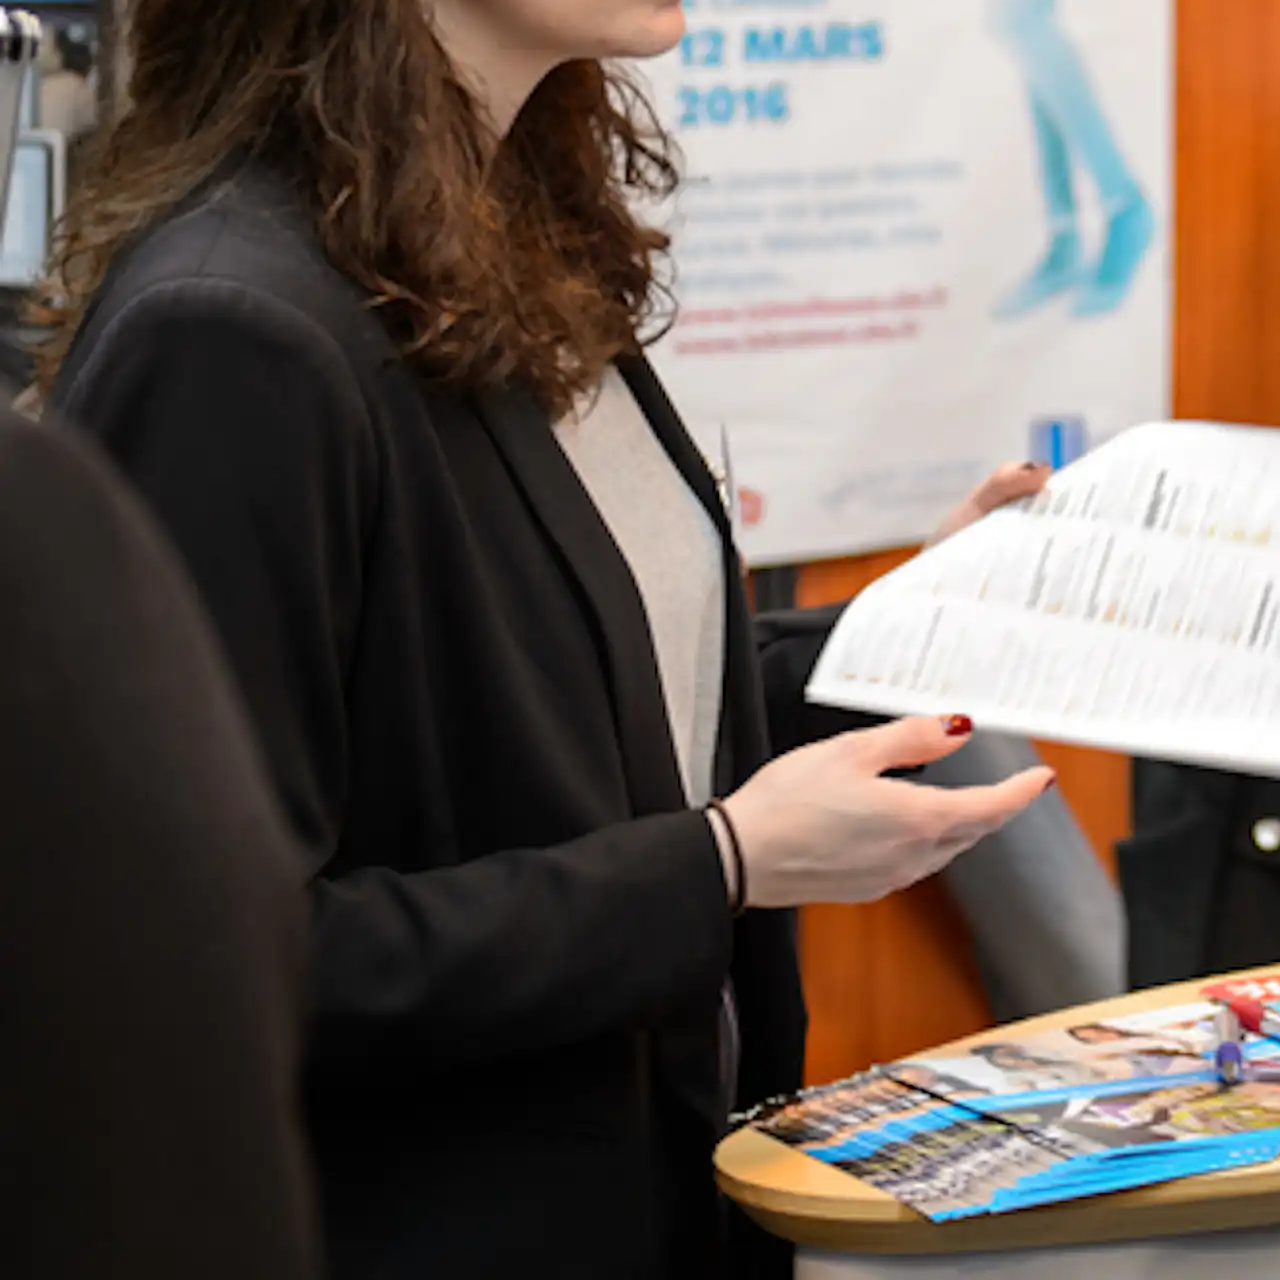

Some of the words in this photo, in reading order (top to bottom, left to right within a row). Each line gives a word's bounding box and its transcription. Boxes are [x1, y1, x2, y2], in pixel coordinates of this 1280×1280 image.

[681, 27, 726, 68] 12
[742, 19, 885, 63] MARS
[676, 80, 789, 127] 2016
